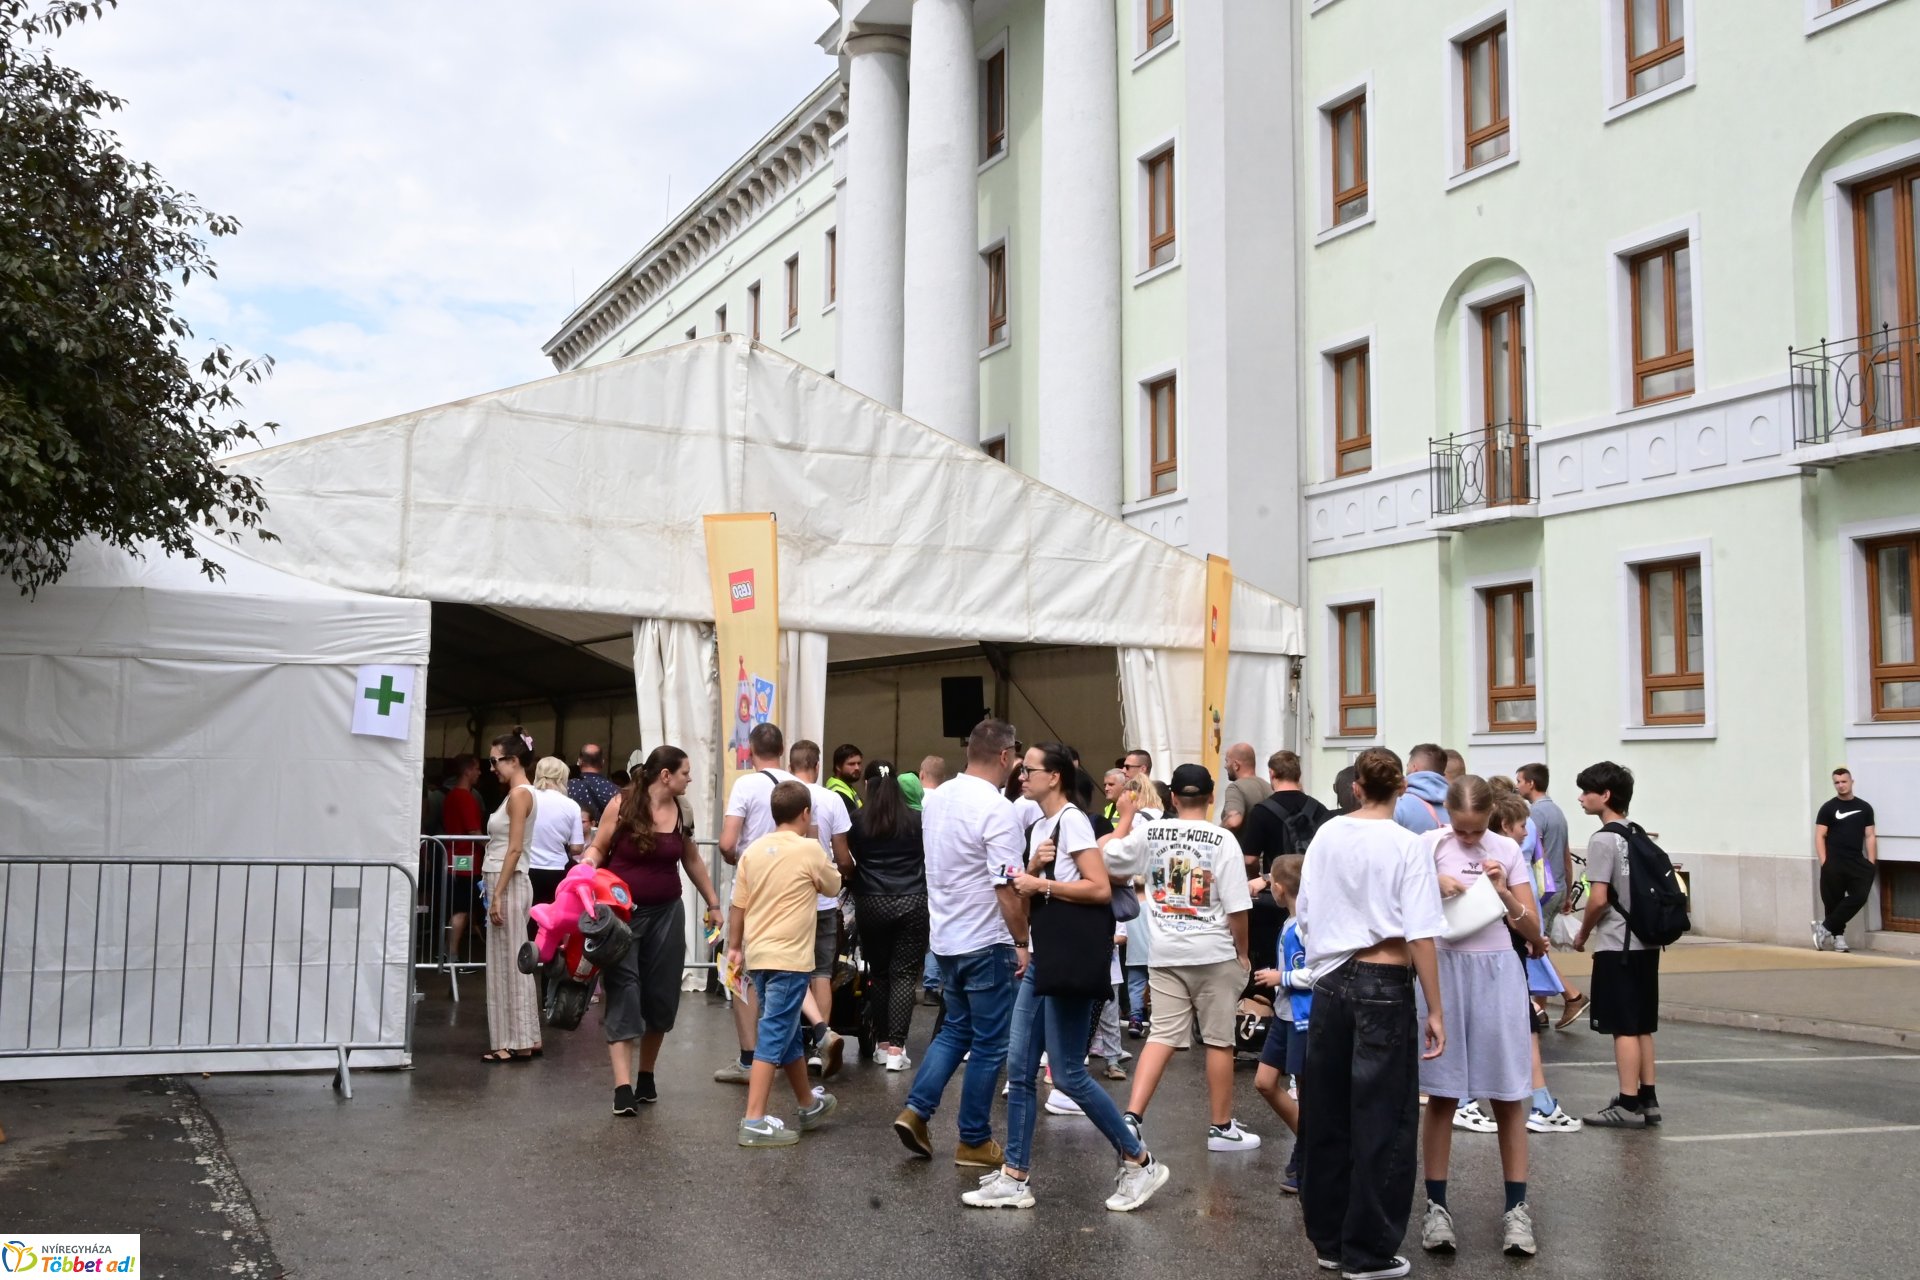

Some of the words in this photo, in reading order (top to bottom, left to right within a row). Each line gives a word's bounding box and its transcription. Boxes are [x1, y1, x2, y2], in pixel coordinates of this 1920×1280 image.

[1147, 828, 1178, 841] SKATE
[1187, 828, 1223, 847] WORLD
[1156, 845, 1169, 858] START
[1192, 847, 1203, 860] YORK
